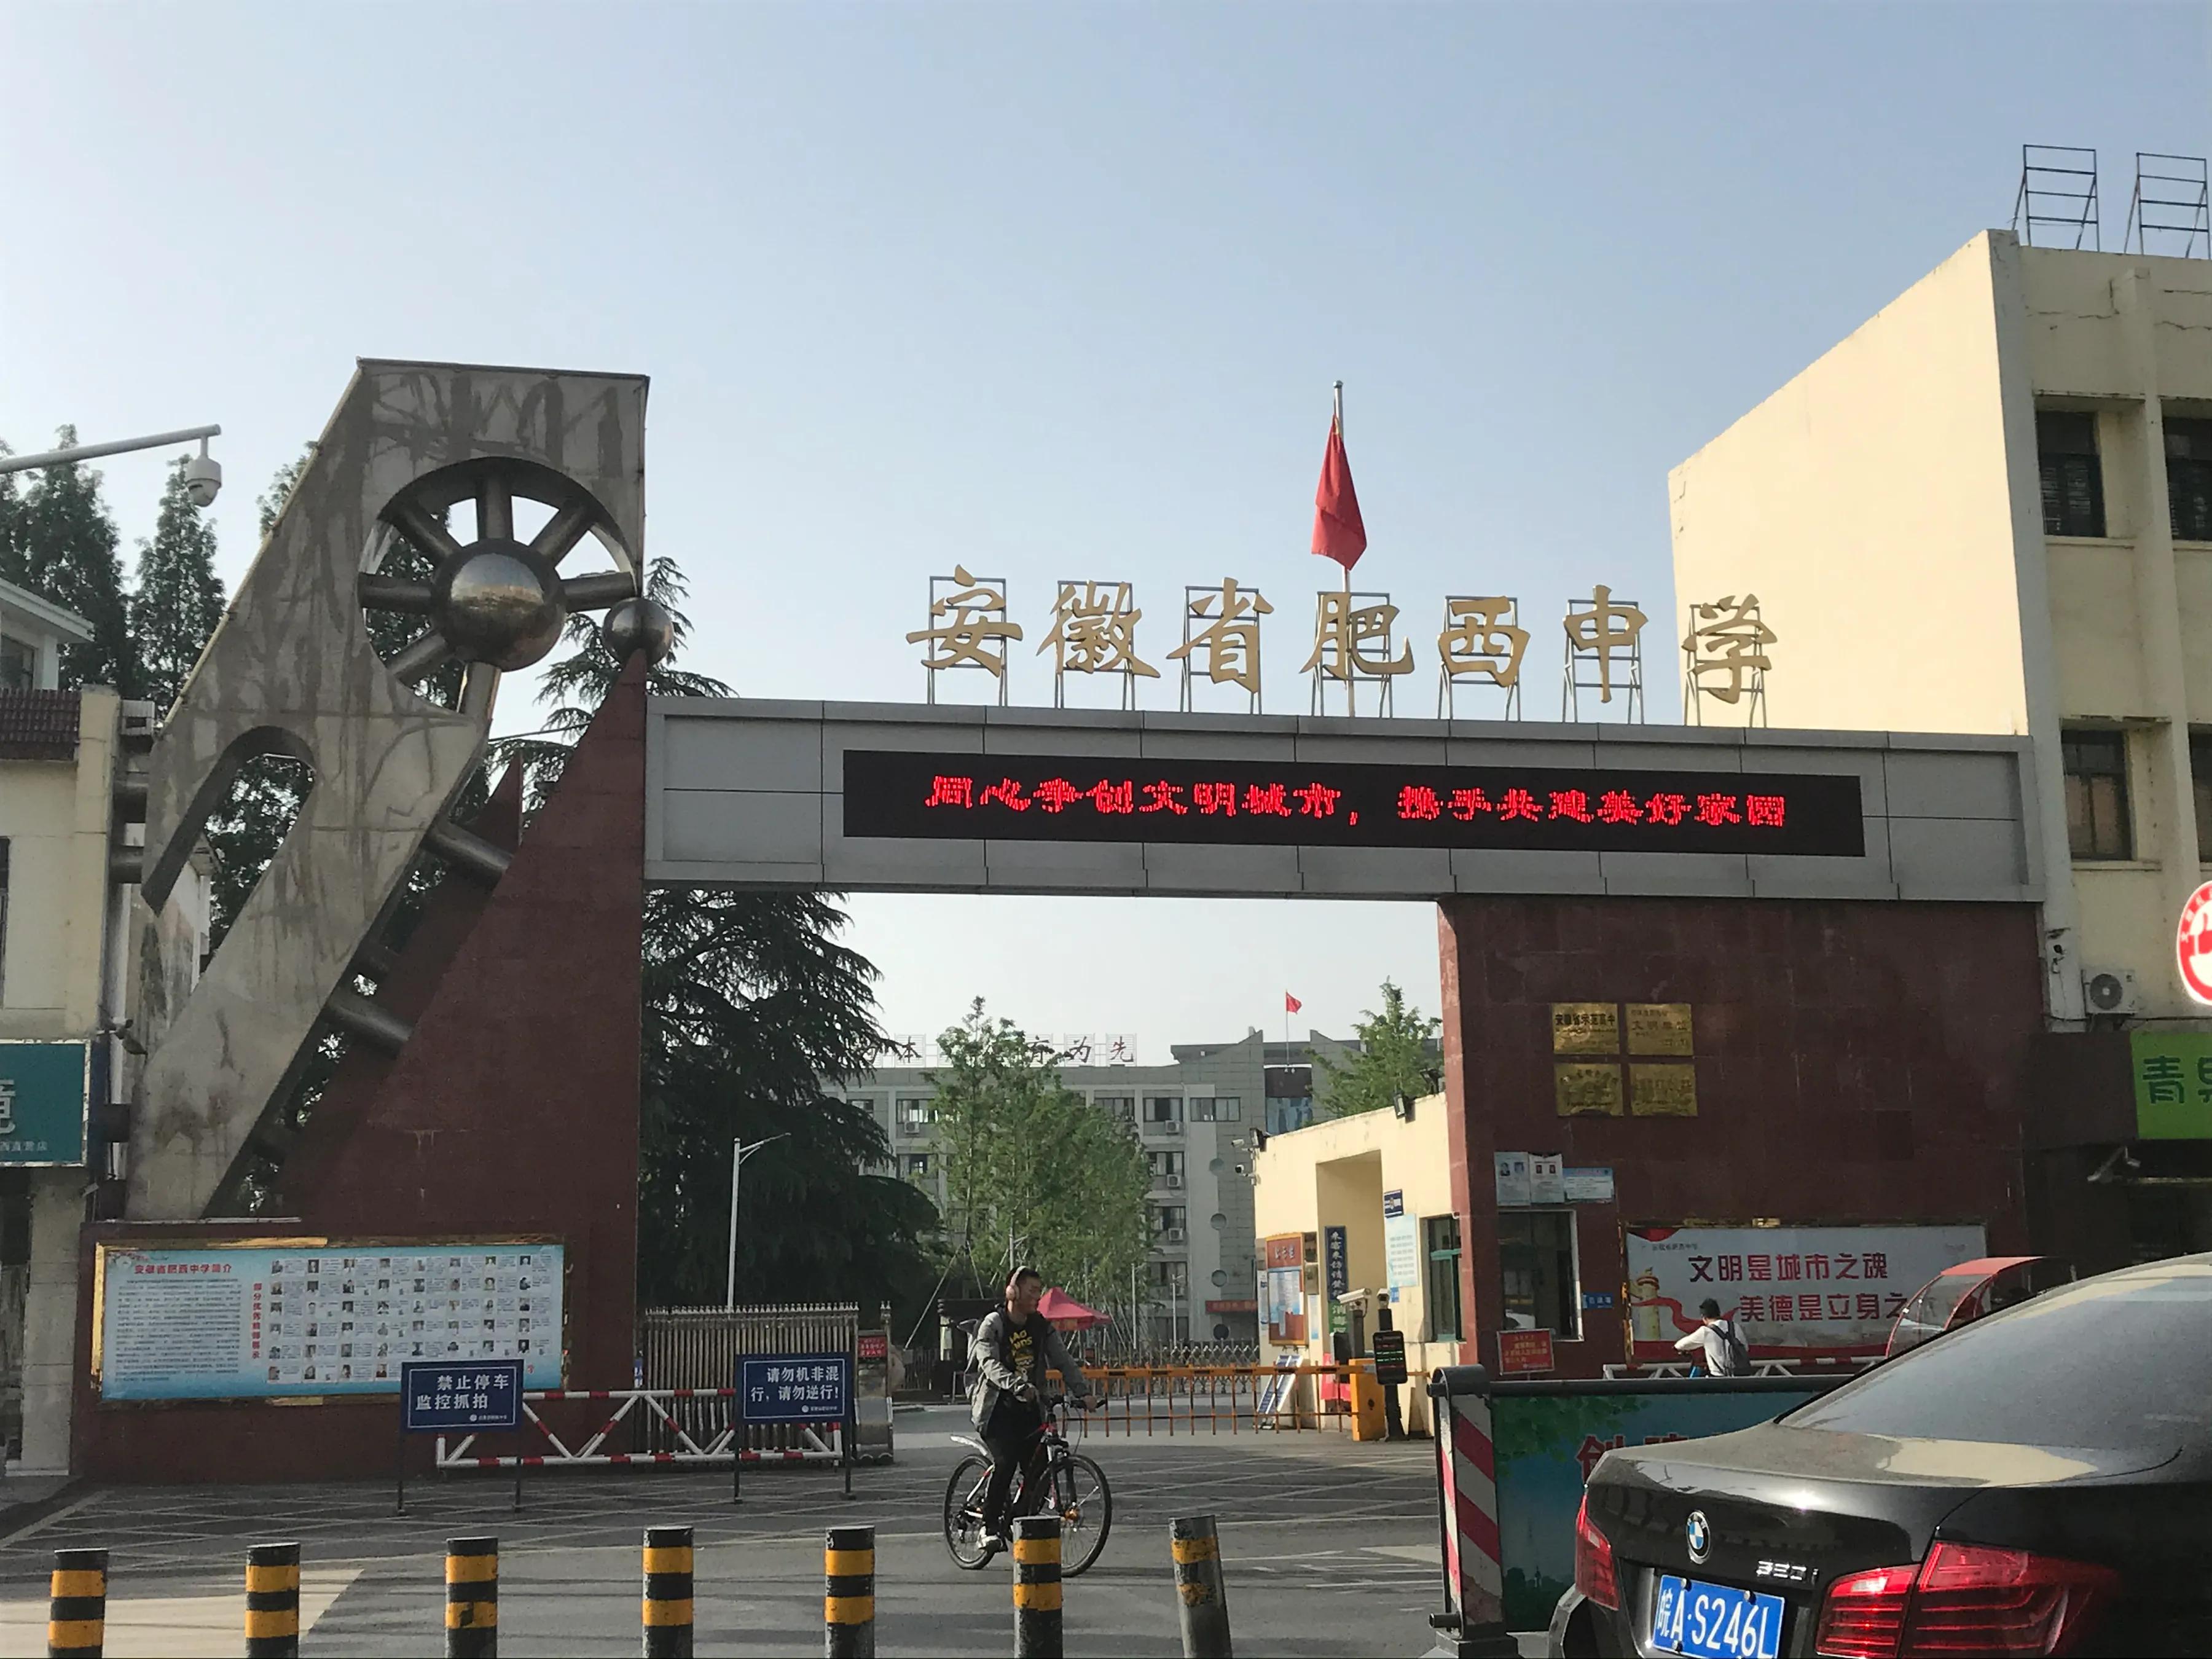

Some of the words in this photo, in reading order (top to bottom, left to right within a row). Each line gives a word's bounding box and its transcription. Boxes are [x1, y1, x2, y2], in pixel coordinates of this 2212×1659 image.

[906, 563, 1778, 705] 安徽省肥西中学
[1688, 1251, 1888, 1282] 文明是城市之魂
[437, 1374, 509, 1391] 禁止停车
[767, 1366, 839, 1382] 请勿机非混
[415, 1393, 488, 1410] 监控抓拍
